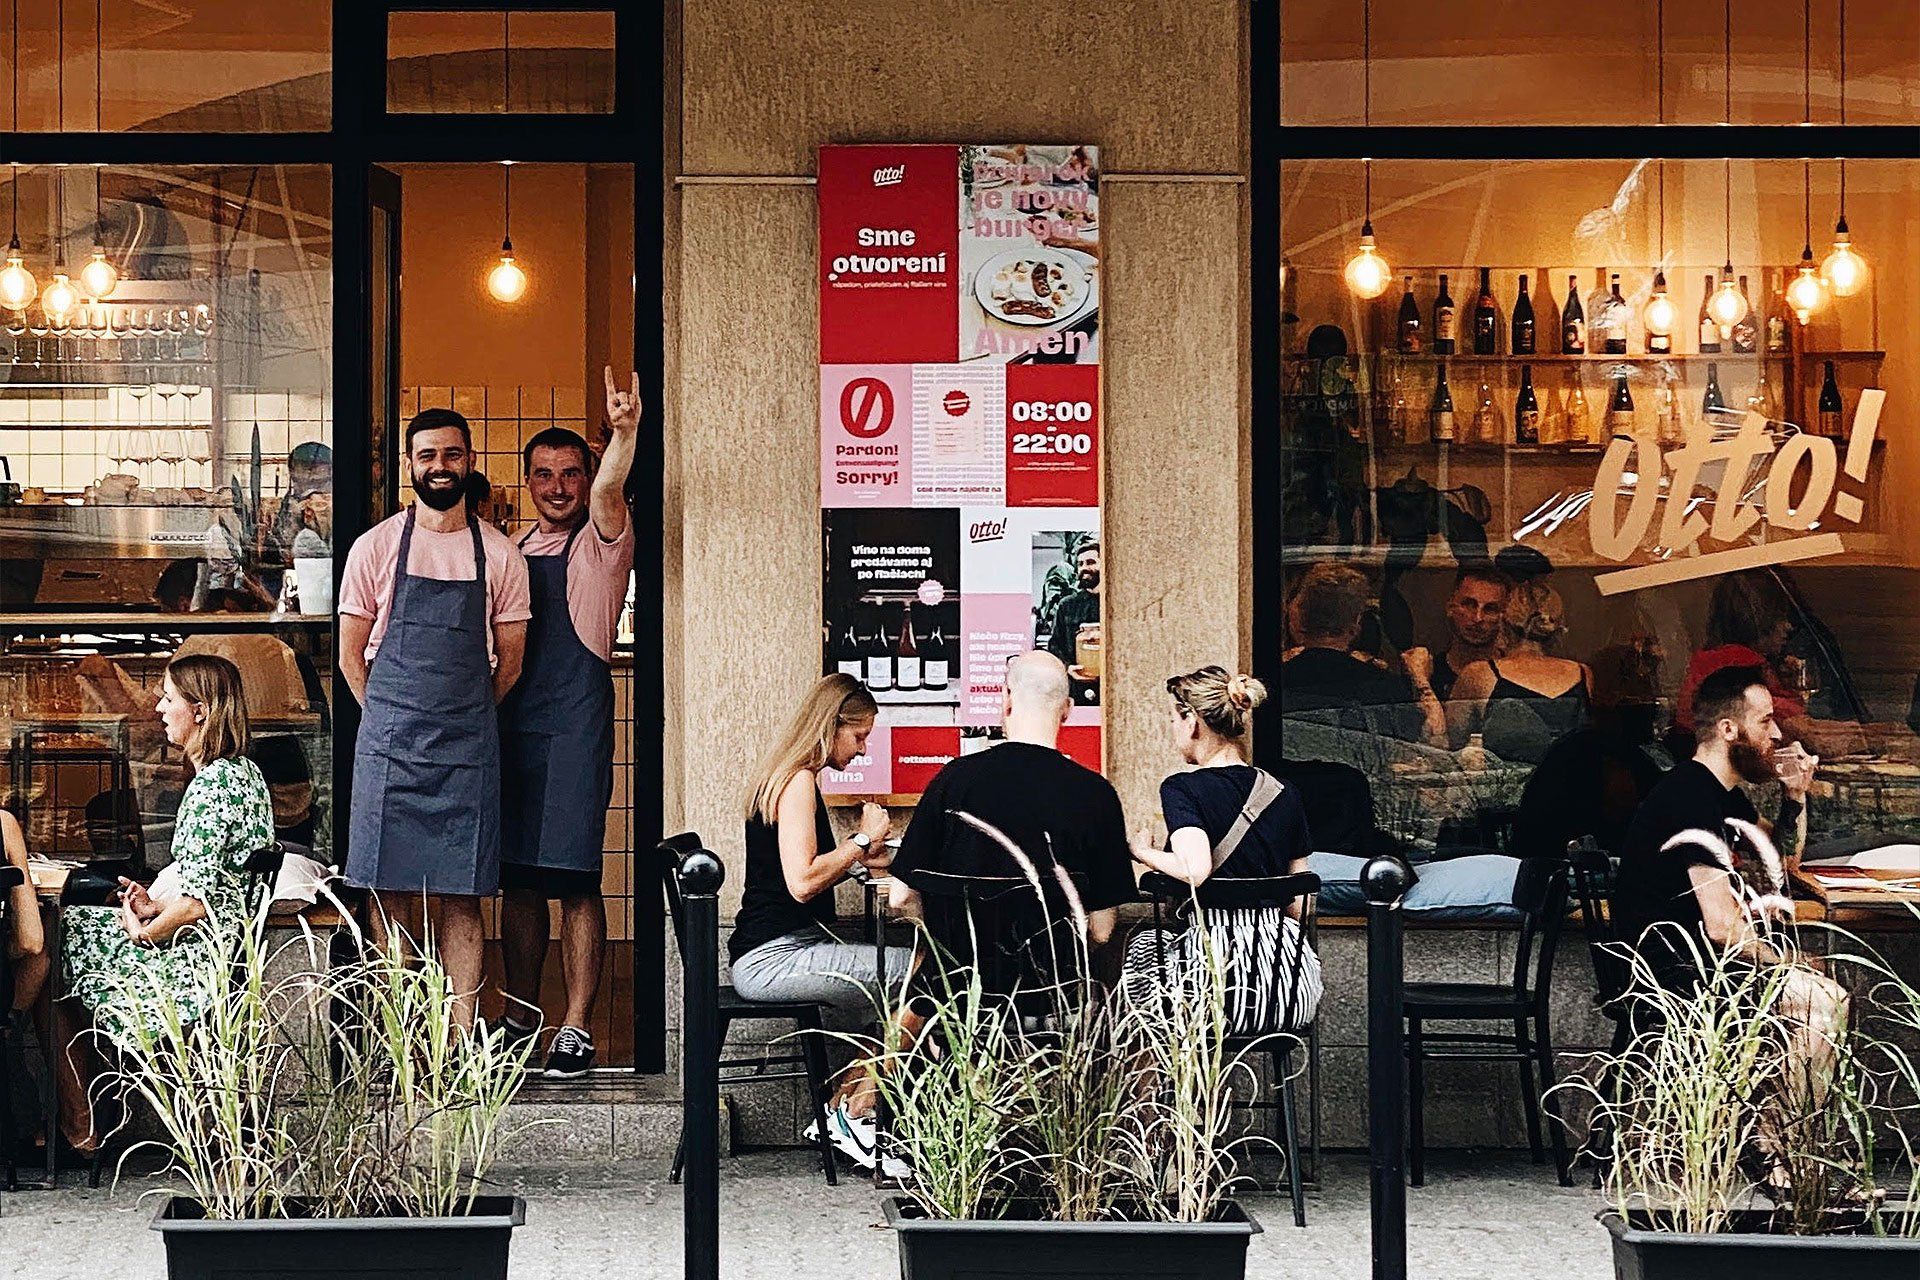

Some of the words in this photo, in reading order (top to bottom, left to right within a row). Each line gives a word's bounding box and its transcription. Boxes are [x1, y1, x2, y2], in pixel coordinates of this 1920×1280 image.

[858, 228, 916, 246] Sme
[974, 217, 1080, 241] burger
[832, 252, 947, 274] otvorení
[975, 328, 1090, 355] Amen
[1012, 401, 1092, 422] 08:00
[836, 444, 899, 456] Pardon!
[1012, 433, 1092, 454] 22:00
[836, 471, 899, 486] Sorry!
[857, 570, 873, 580] po
